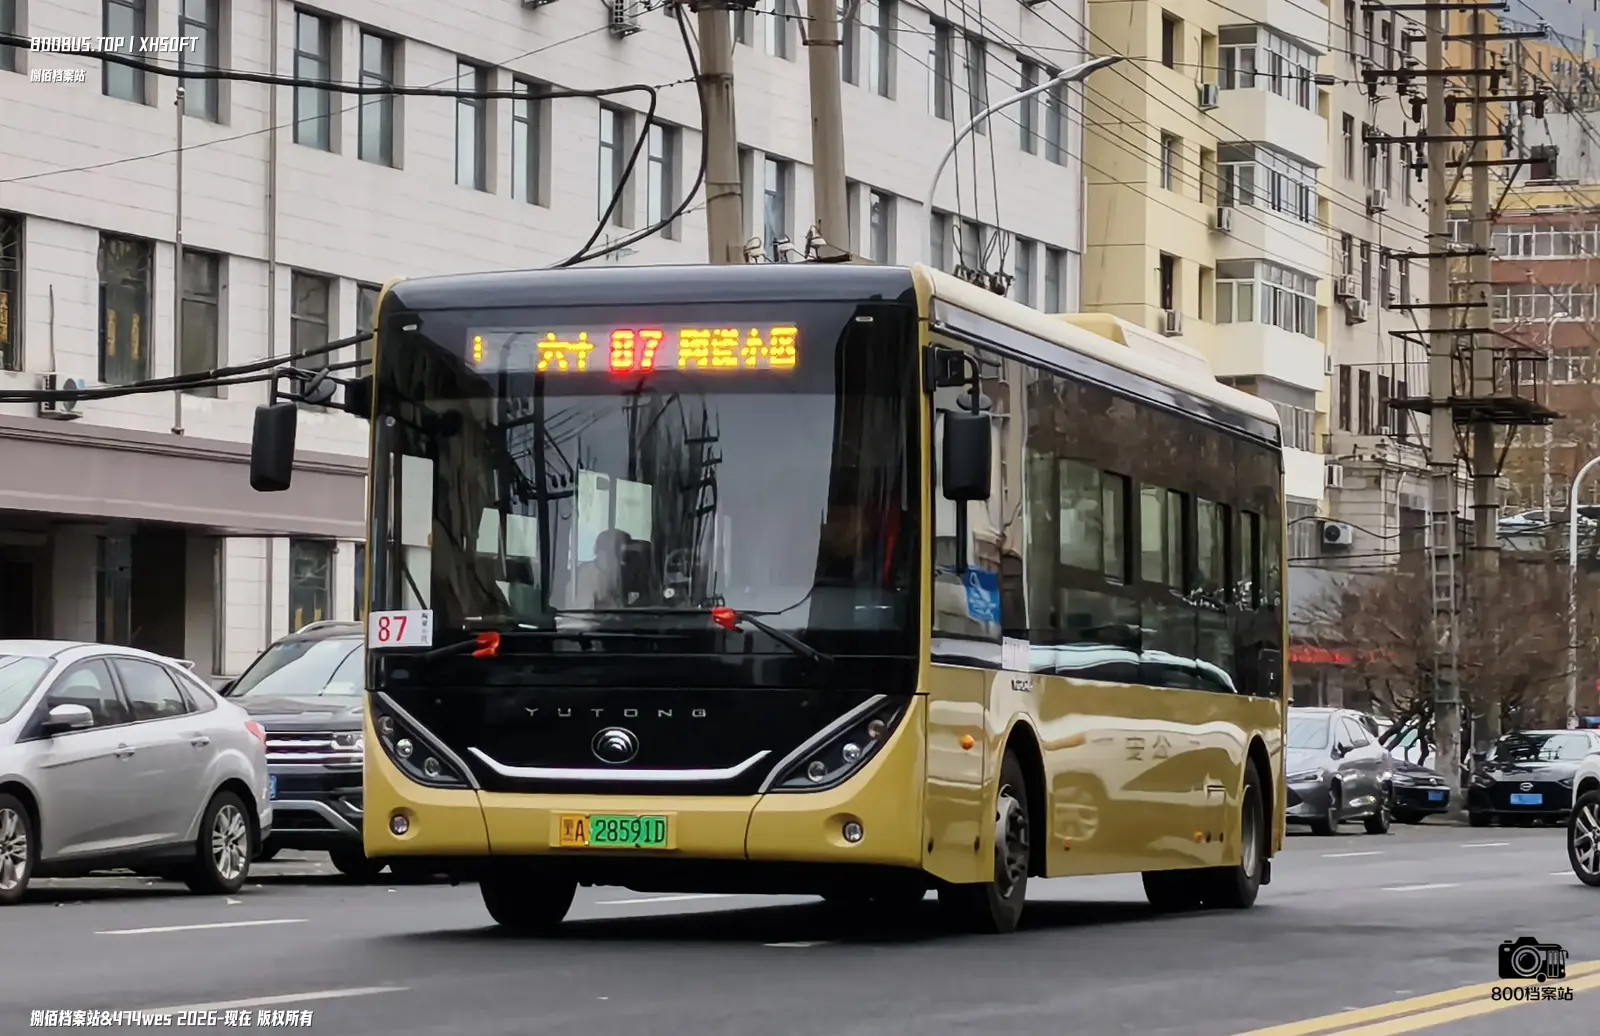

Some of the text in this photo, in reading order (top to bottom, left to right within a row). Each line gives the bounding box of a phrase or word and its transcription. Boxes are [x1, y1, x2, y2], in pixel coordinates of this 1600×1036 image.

[610, 329, 664, 371] 87
[378, 616, 408, 642] 87
[525, 707, 707, 718] YUTONG
